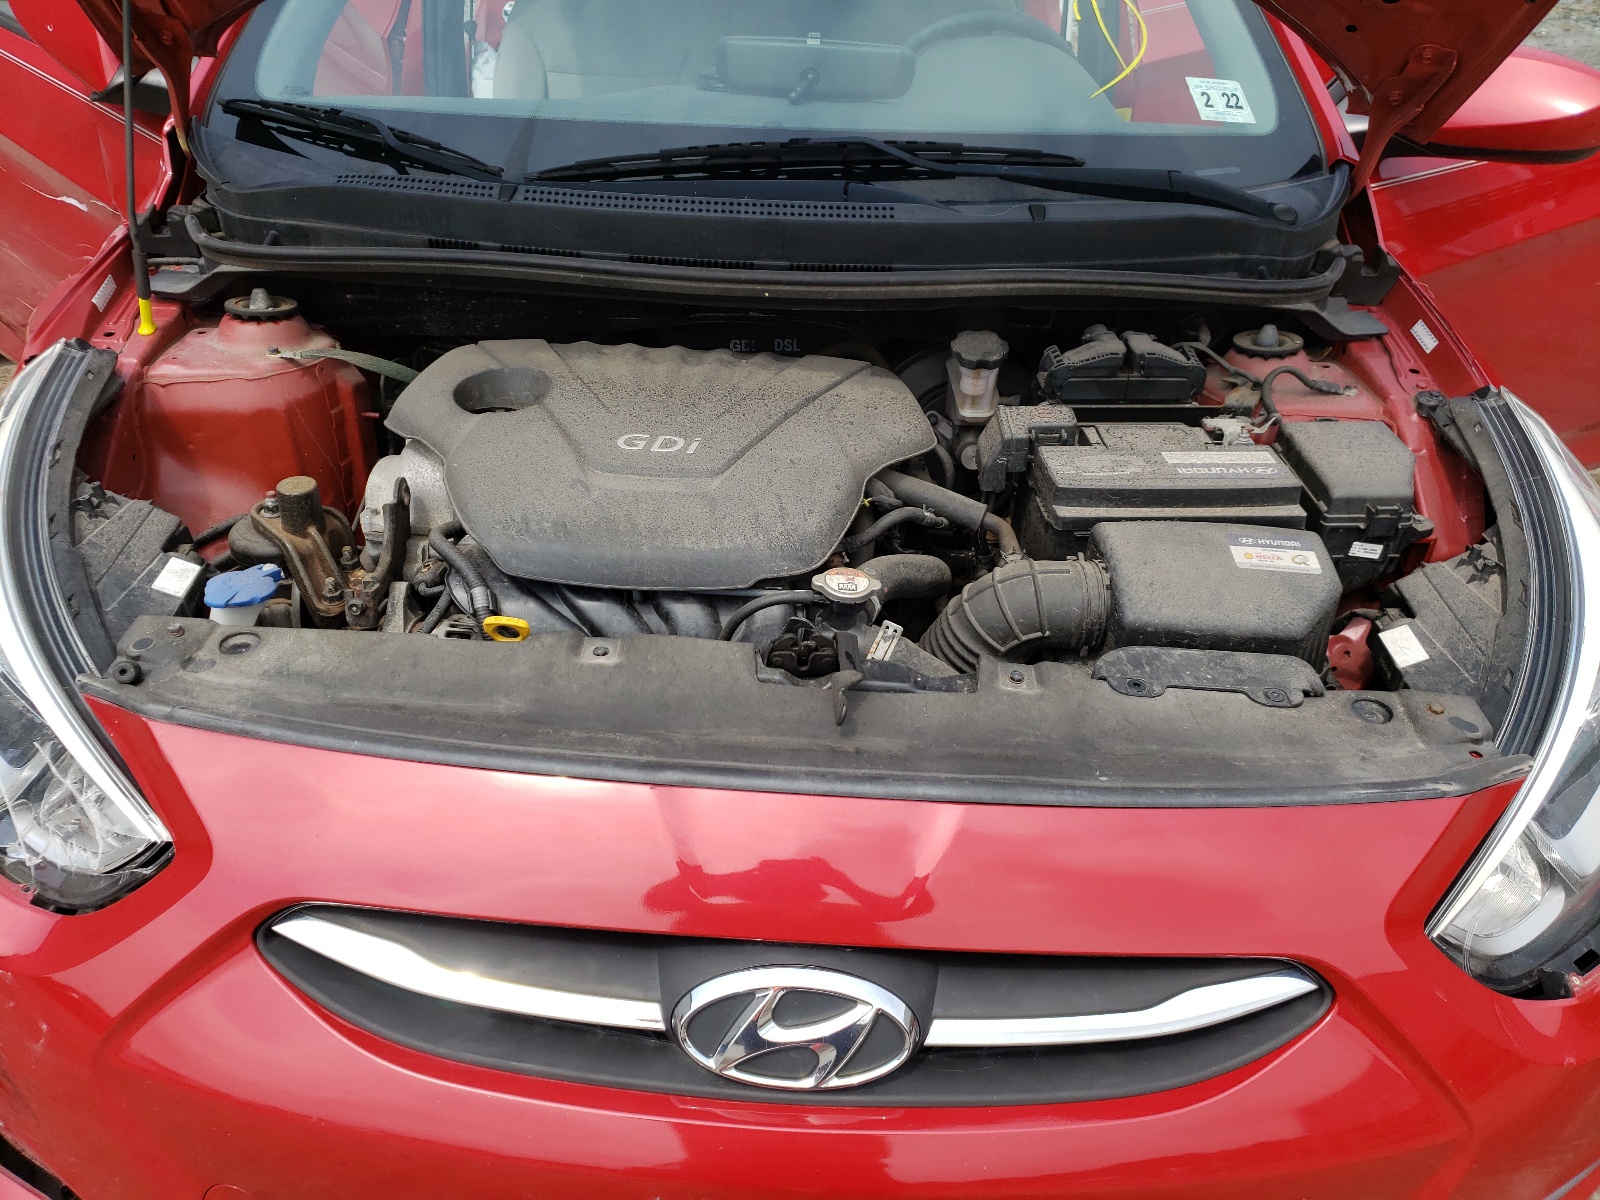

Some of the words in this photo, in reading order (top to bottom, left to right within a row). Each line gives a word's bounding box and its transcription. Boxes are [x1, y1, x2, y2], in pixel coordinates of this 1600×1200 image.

[1201, 92, 1215, 108] 2
[1222, 92, 1244, 109] 22
[774, 339, 801, 352] DSL
[617, 433, 702, 454] GDi
[1177, 466, 1251, 474] HYUNDAI
[1257, 538, 1301, 547] HYUNDAI
